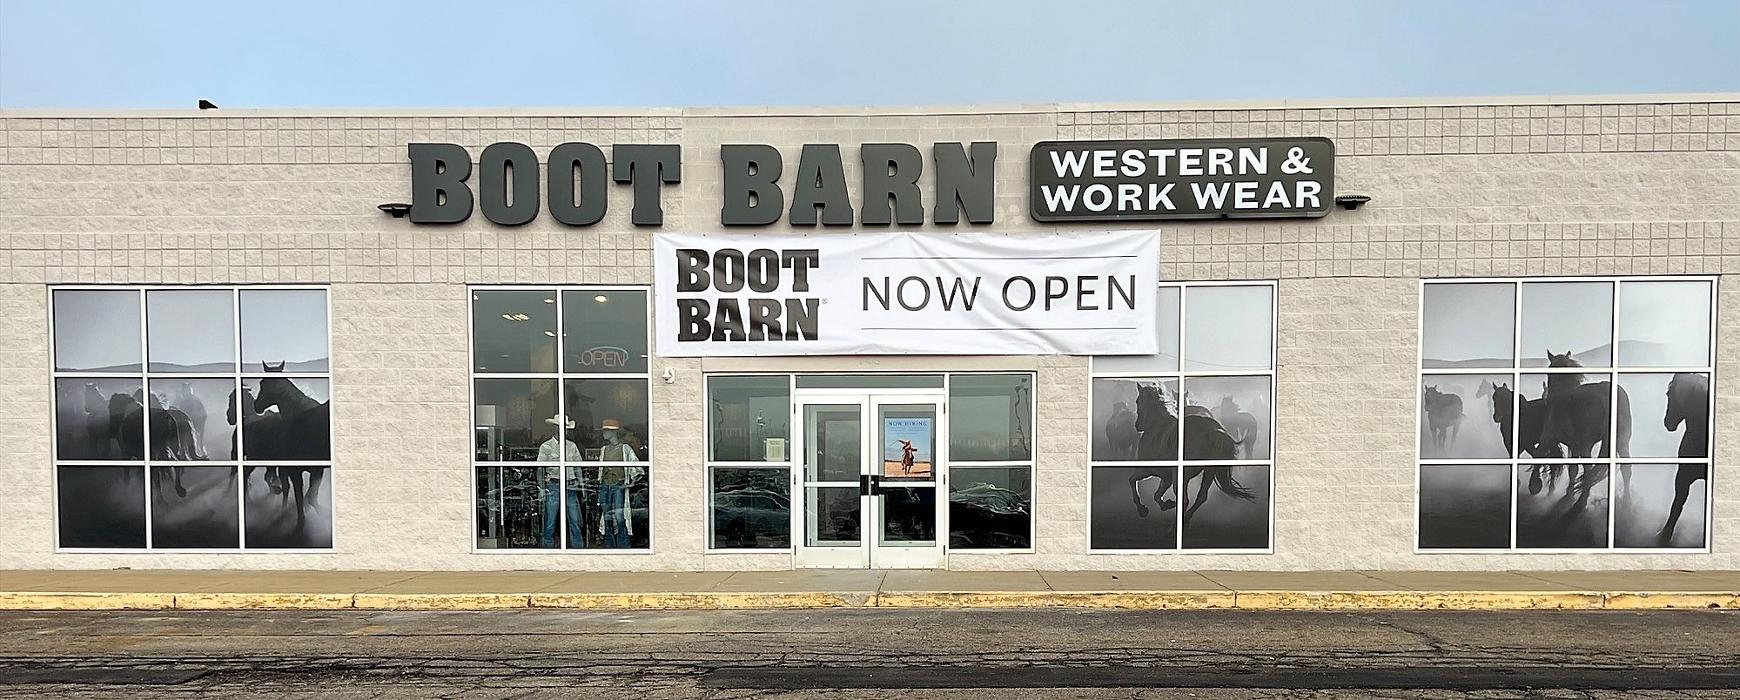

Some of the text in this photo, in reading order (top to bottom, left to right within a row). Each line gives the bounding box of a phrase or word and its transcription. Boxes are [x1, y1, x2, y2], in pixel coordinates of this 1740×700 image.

[1049, 146, 1313, 178] WESTERN &
[408, 141, 998, 227] BOOT BARN
[1040, 180, 1322, 212] WORK WEAR
[676, 248, 819, 292] BOOT
[862, 274, 1136, 312] NOW OPEN
[677, 298, 819, 342] BARN
[581, 350, 625, 367] OPEN
